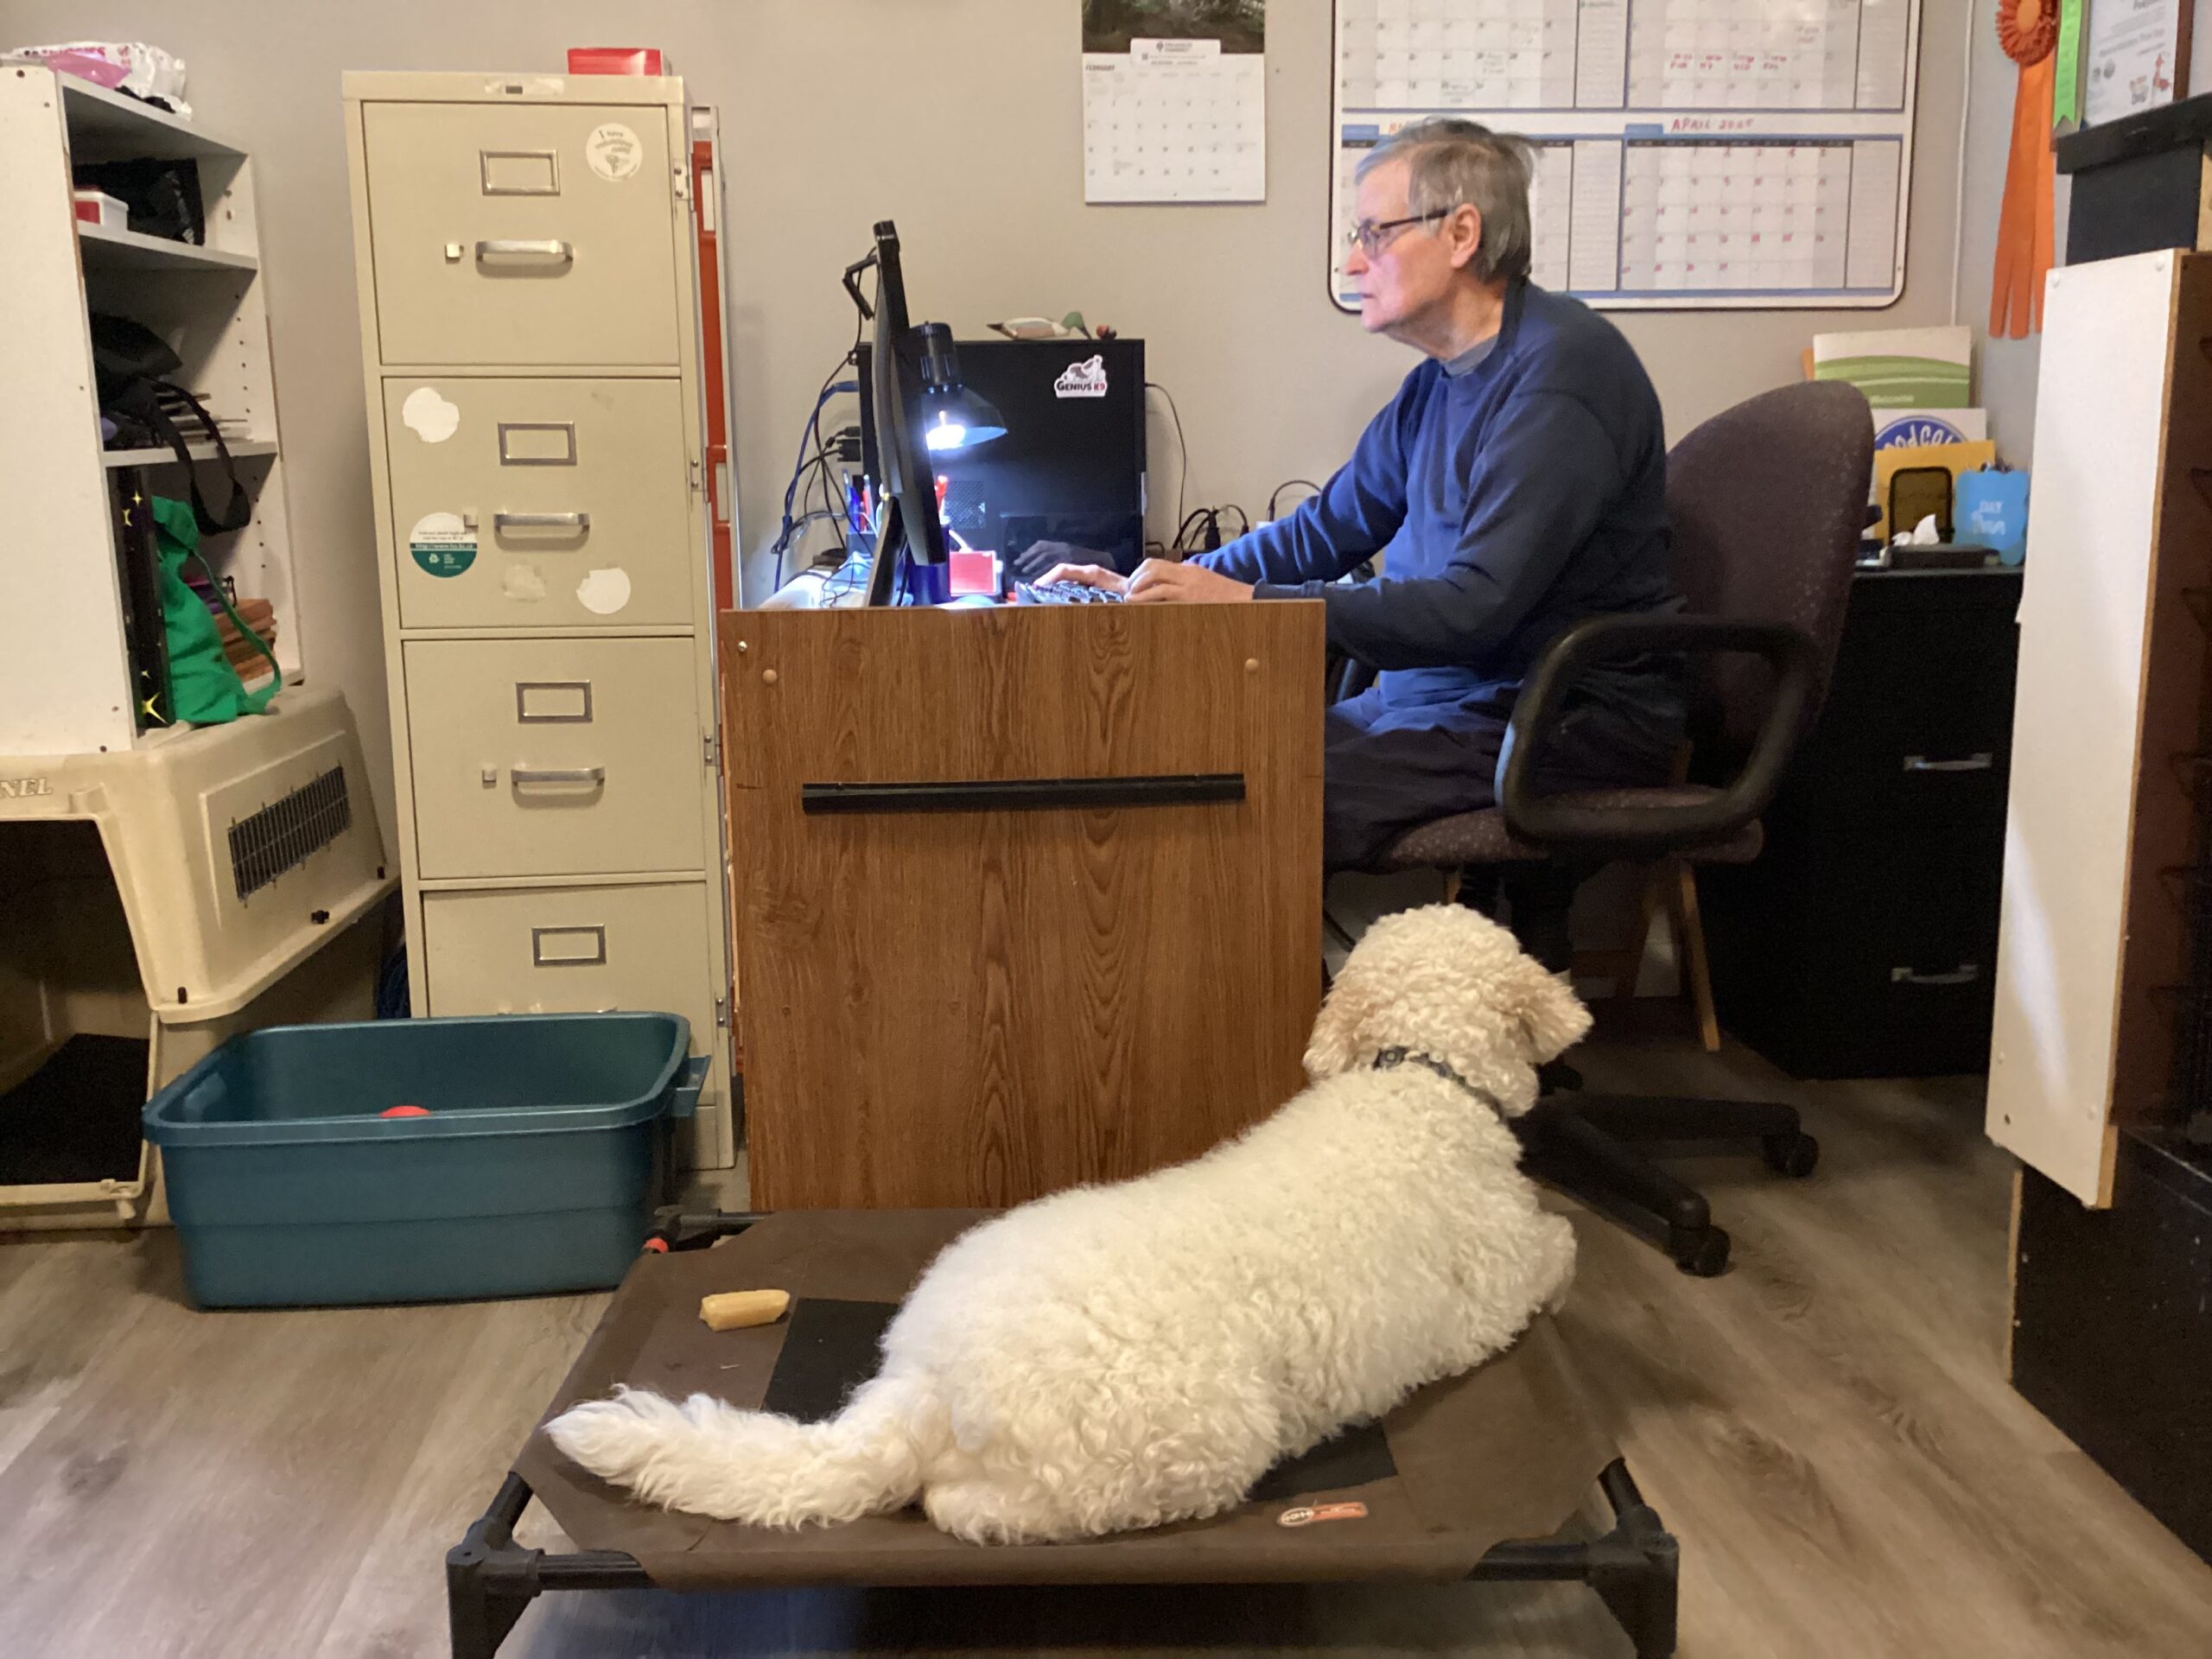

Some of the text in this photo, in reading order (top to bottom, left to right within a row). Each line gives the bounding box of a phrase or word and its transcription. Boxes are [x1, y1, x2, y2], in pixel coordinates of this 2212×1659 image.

[1672, 118, 1710, 130] APRIL
[1057, 381, 1106, 391] GENIUS K9
